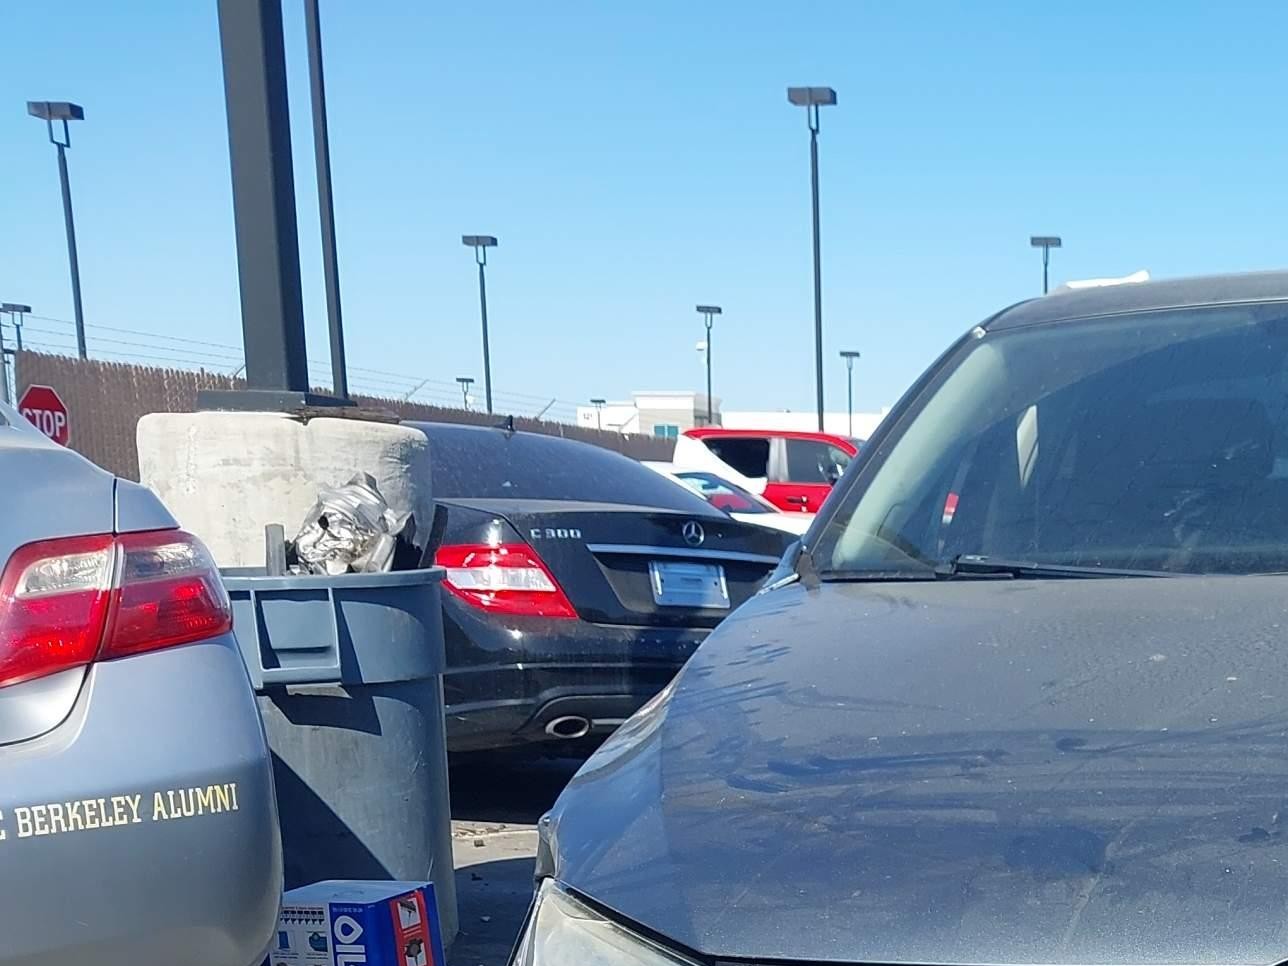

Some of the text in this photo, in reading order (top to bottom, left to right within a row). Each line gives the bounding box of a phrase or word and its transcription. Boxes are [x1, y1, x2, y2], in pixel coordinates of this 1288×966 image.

[530, 528, 541, 539] C
[14, 794, 142, 838] BERKELEY
[152, 783, 239, 821] ALUMNI
